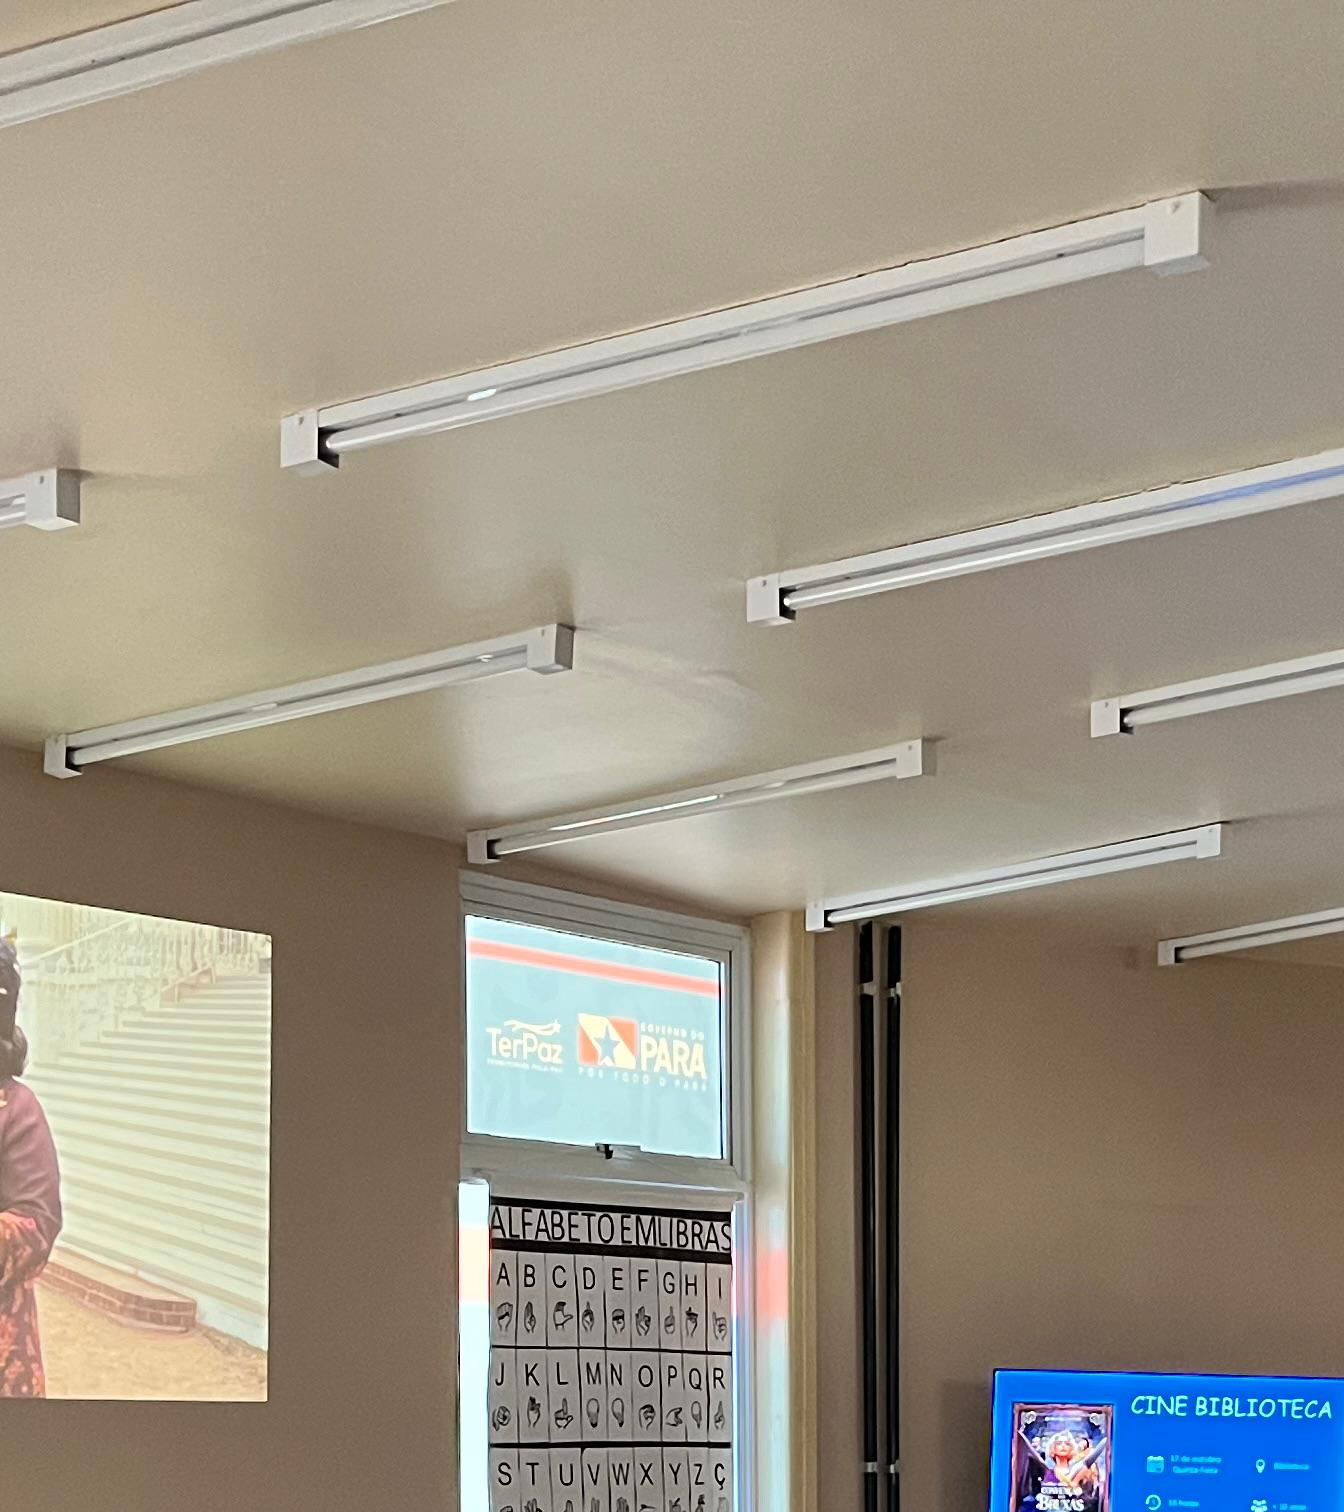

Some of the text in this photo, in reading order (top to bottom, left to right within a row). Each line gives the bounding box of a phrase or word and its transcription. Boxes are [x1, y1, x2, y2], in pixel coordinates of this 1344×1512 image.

[485, 1027, 564, 1065] TerPaz
[490, 1206, 615, 1244] ALFABETO
[496, 1263, 722, 1299] A B C D E F G H I
[495, 1362, 726, 1391] J K L M N O P Q R
[1131, 1395, 1332, 1419] CINE BIBLIOTECA
[497, 1462, 726, 1490] S T U V W X Y Z Ç
